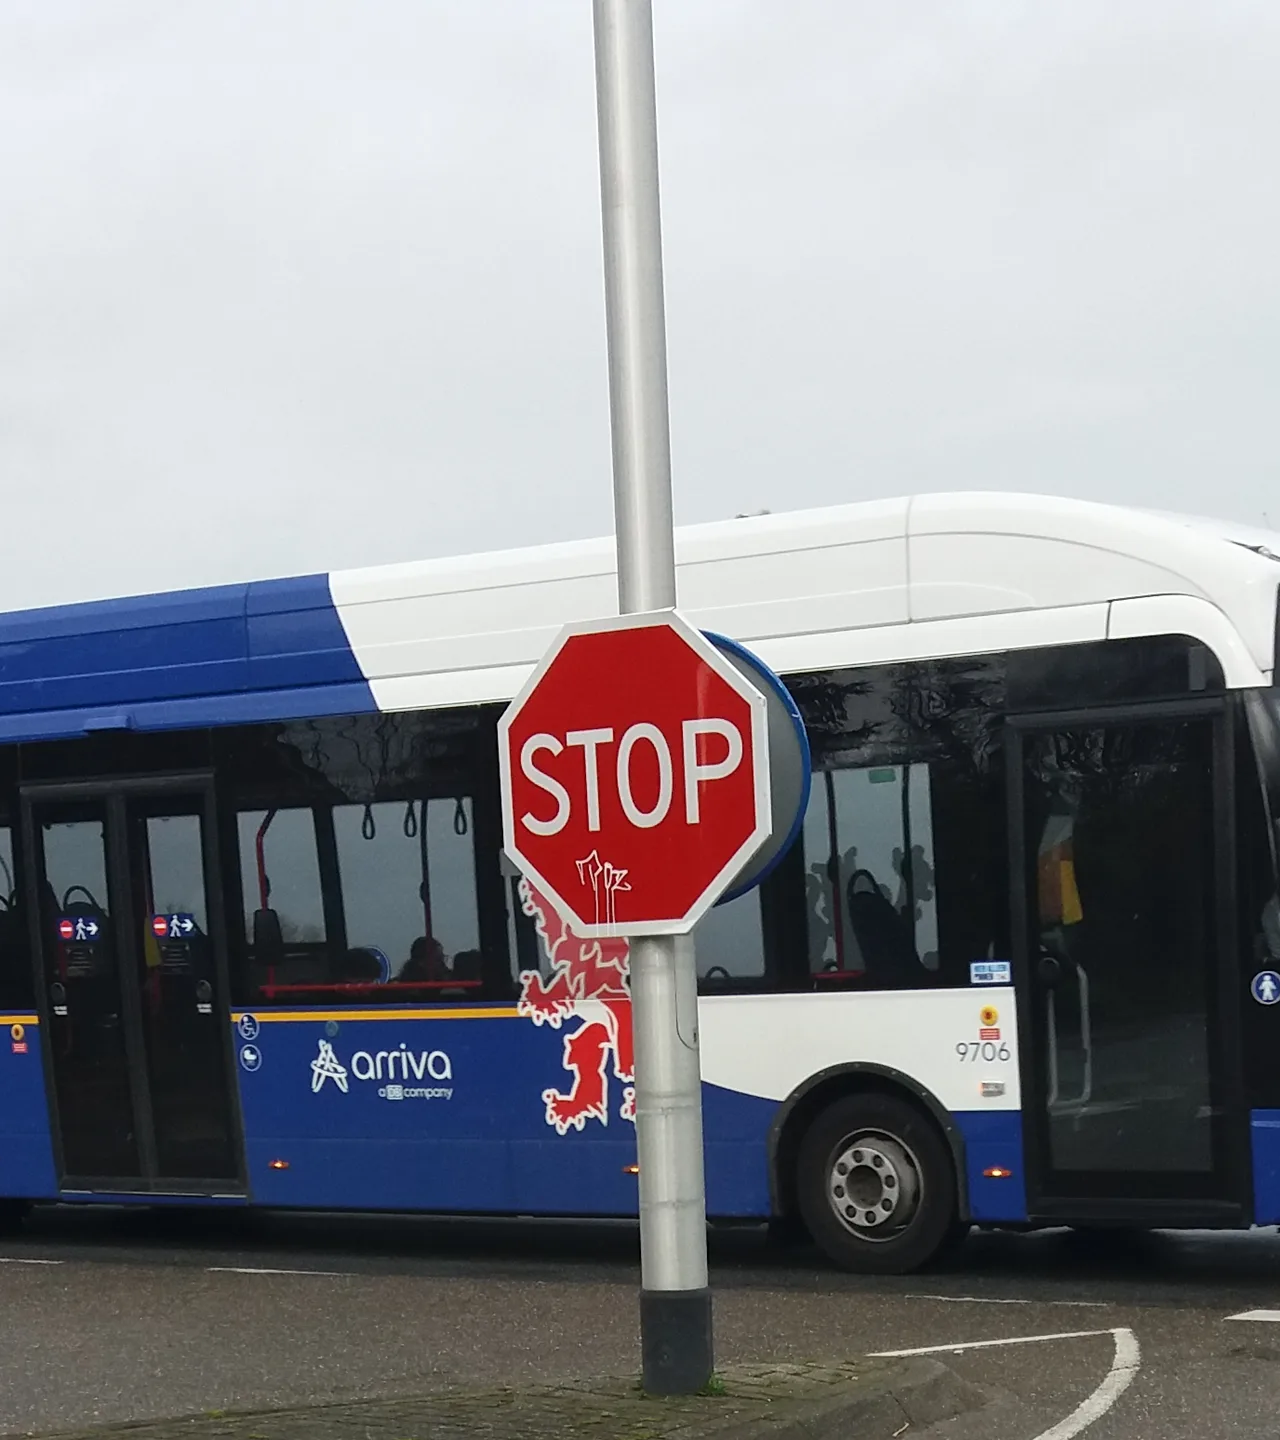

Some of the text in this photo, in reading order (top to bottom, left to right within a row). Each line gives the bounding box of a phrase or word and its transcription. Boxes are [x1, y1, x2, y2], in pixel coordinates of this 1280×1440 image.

[520, 717, 743, 836] STOP
[351, 1043, 452, 1080] arriva
[955, 1042, 1011, 1062] 9706
[404, 1087, 453, 1100] company
